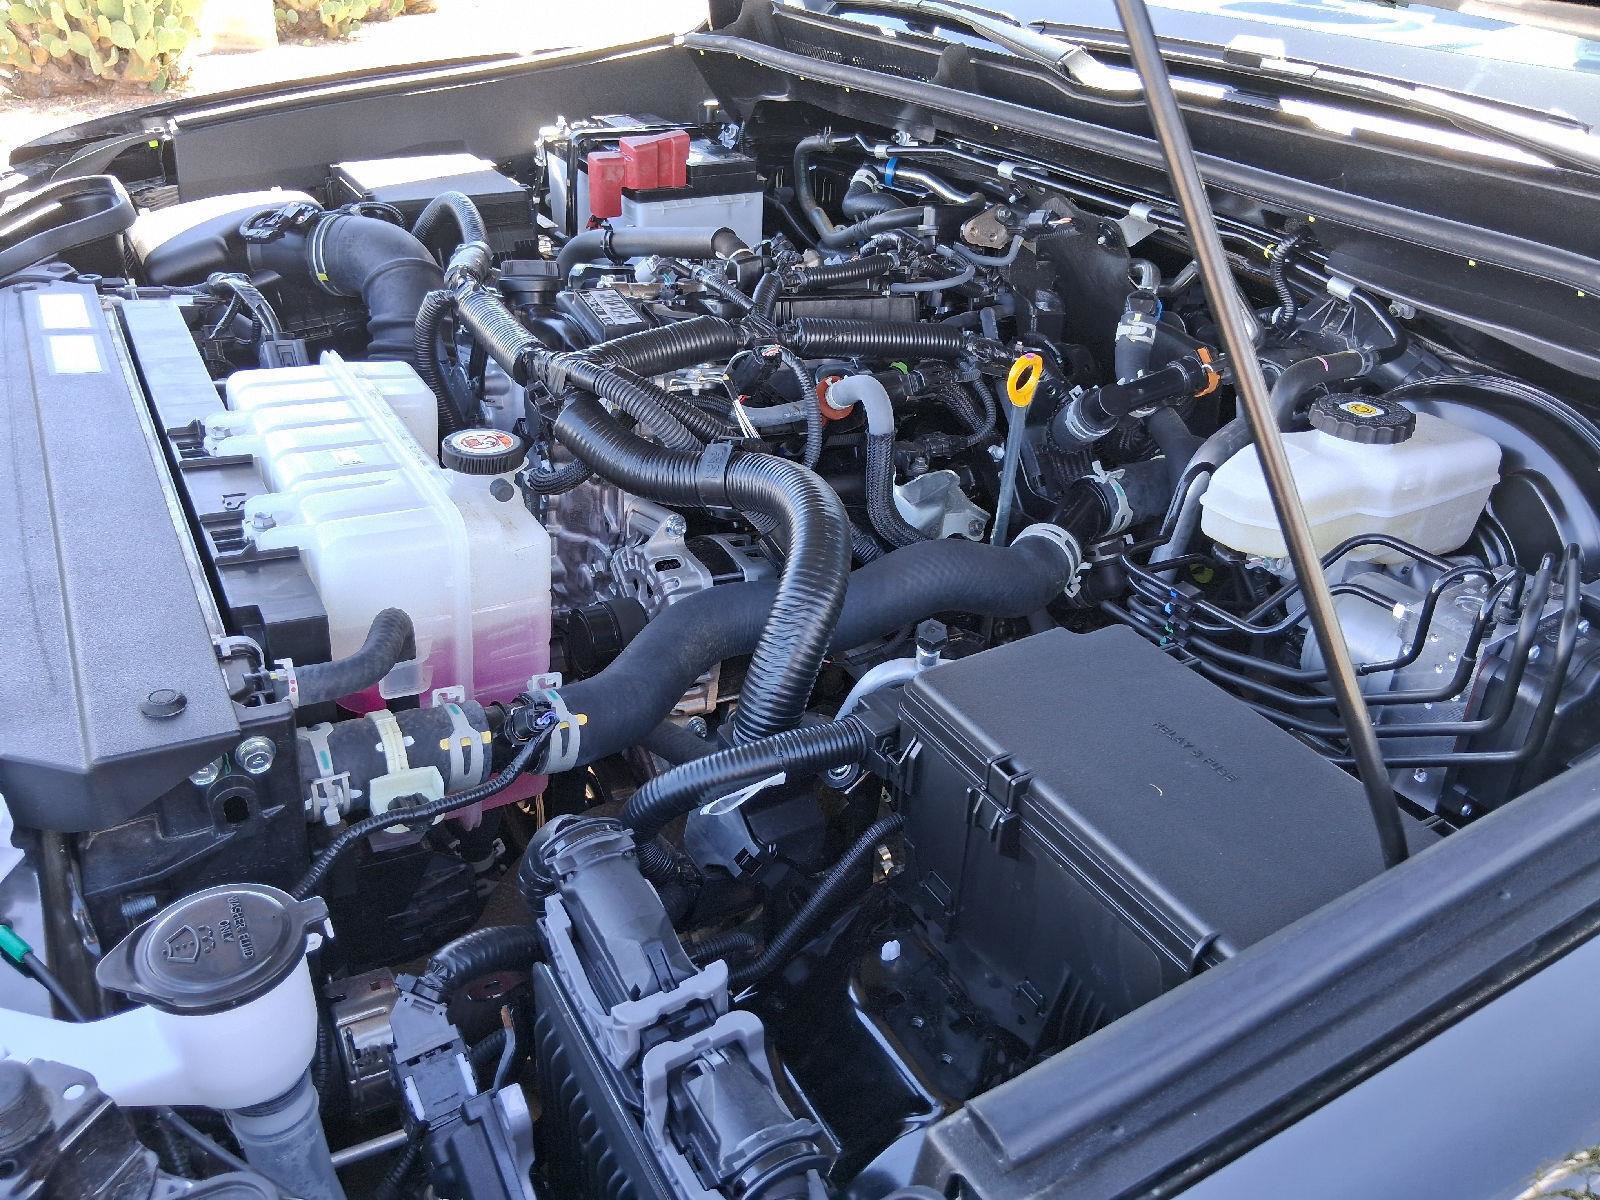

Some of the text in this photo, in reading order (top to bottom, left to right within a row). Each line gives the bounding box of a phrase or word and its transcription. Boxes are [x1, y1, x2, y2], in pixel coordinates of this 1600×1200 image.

[1152, 721, 1194, 747] RELAY
[1203, 758, 1239, 781] FUSE
[219, 919, 235, 943] ONLY
[228, 895, 254, 958] WASHER FLUID
